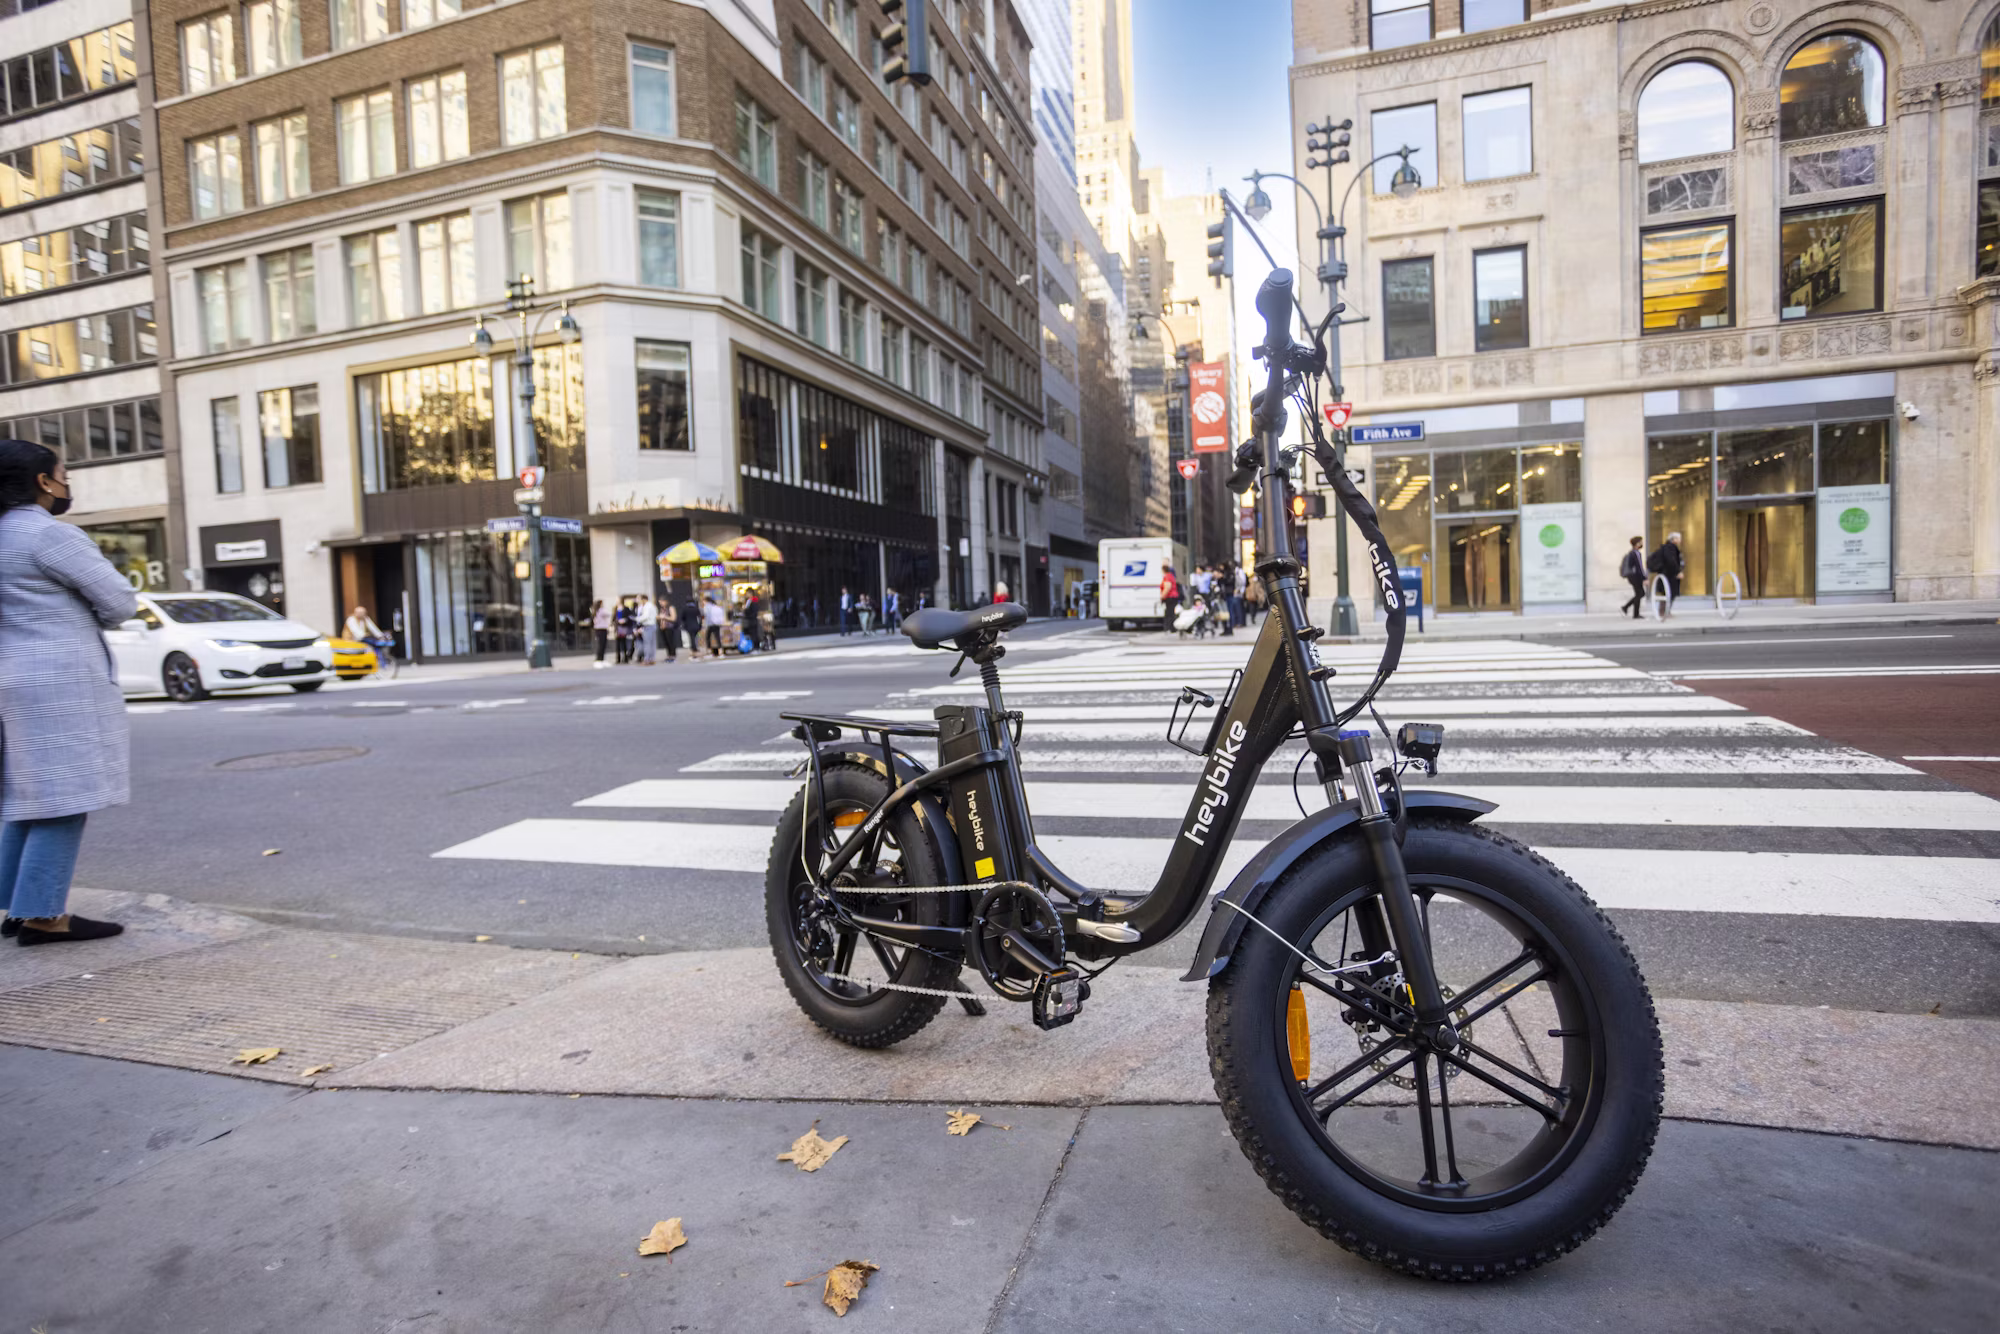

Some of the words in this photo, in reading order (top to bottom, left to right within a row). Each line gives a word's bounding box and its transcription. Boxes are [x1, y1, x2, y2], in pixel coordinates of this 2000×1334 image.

[1363, 428, 1389, 441] Fifth
[1391, 427, 1412, 438] Ave
[981, 612, 1004, 622] heybike
[1183, 720, 1247, 846] heybike
[863, 809, 884, 834] Ranger
[966, 790, 985, 852] heybike
